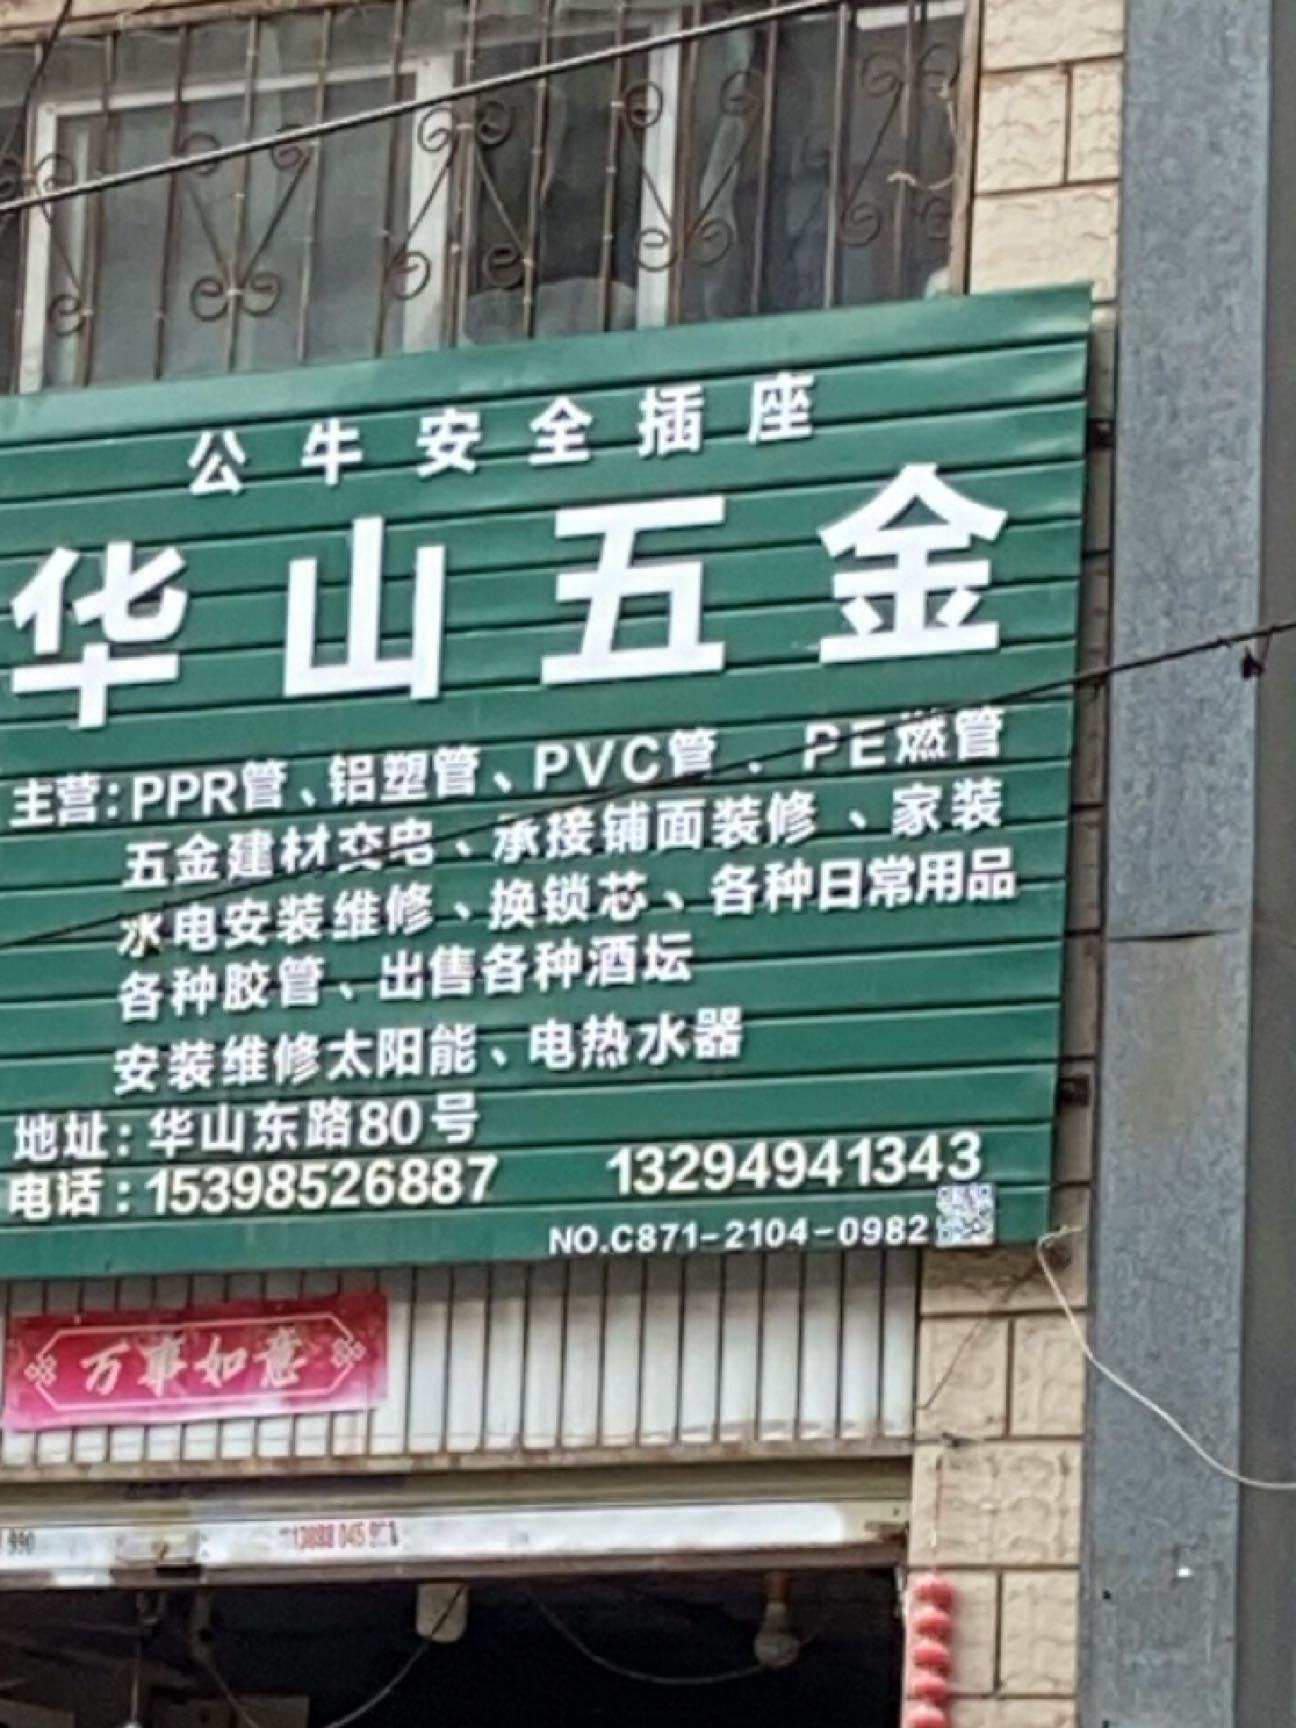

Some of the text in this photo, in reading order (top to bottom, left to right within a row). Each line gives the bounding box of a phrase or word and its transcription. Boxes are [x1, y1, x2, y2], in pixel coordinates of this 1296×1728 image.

[186, 371, 817, 496] 公牛安全插座
[8, 462, 1009, 729] 华山五金
[606, 1130, 982, 1195] 13294941343
[548, 1215, 929, 1255] NO.C871-2104-0982
[80, 1327, 308, 1396] 万事如意
